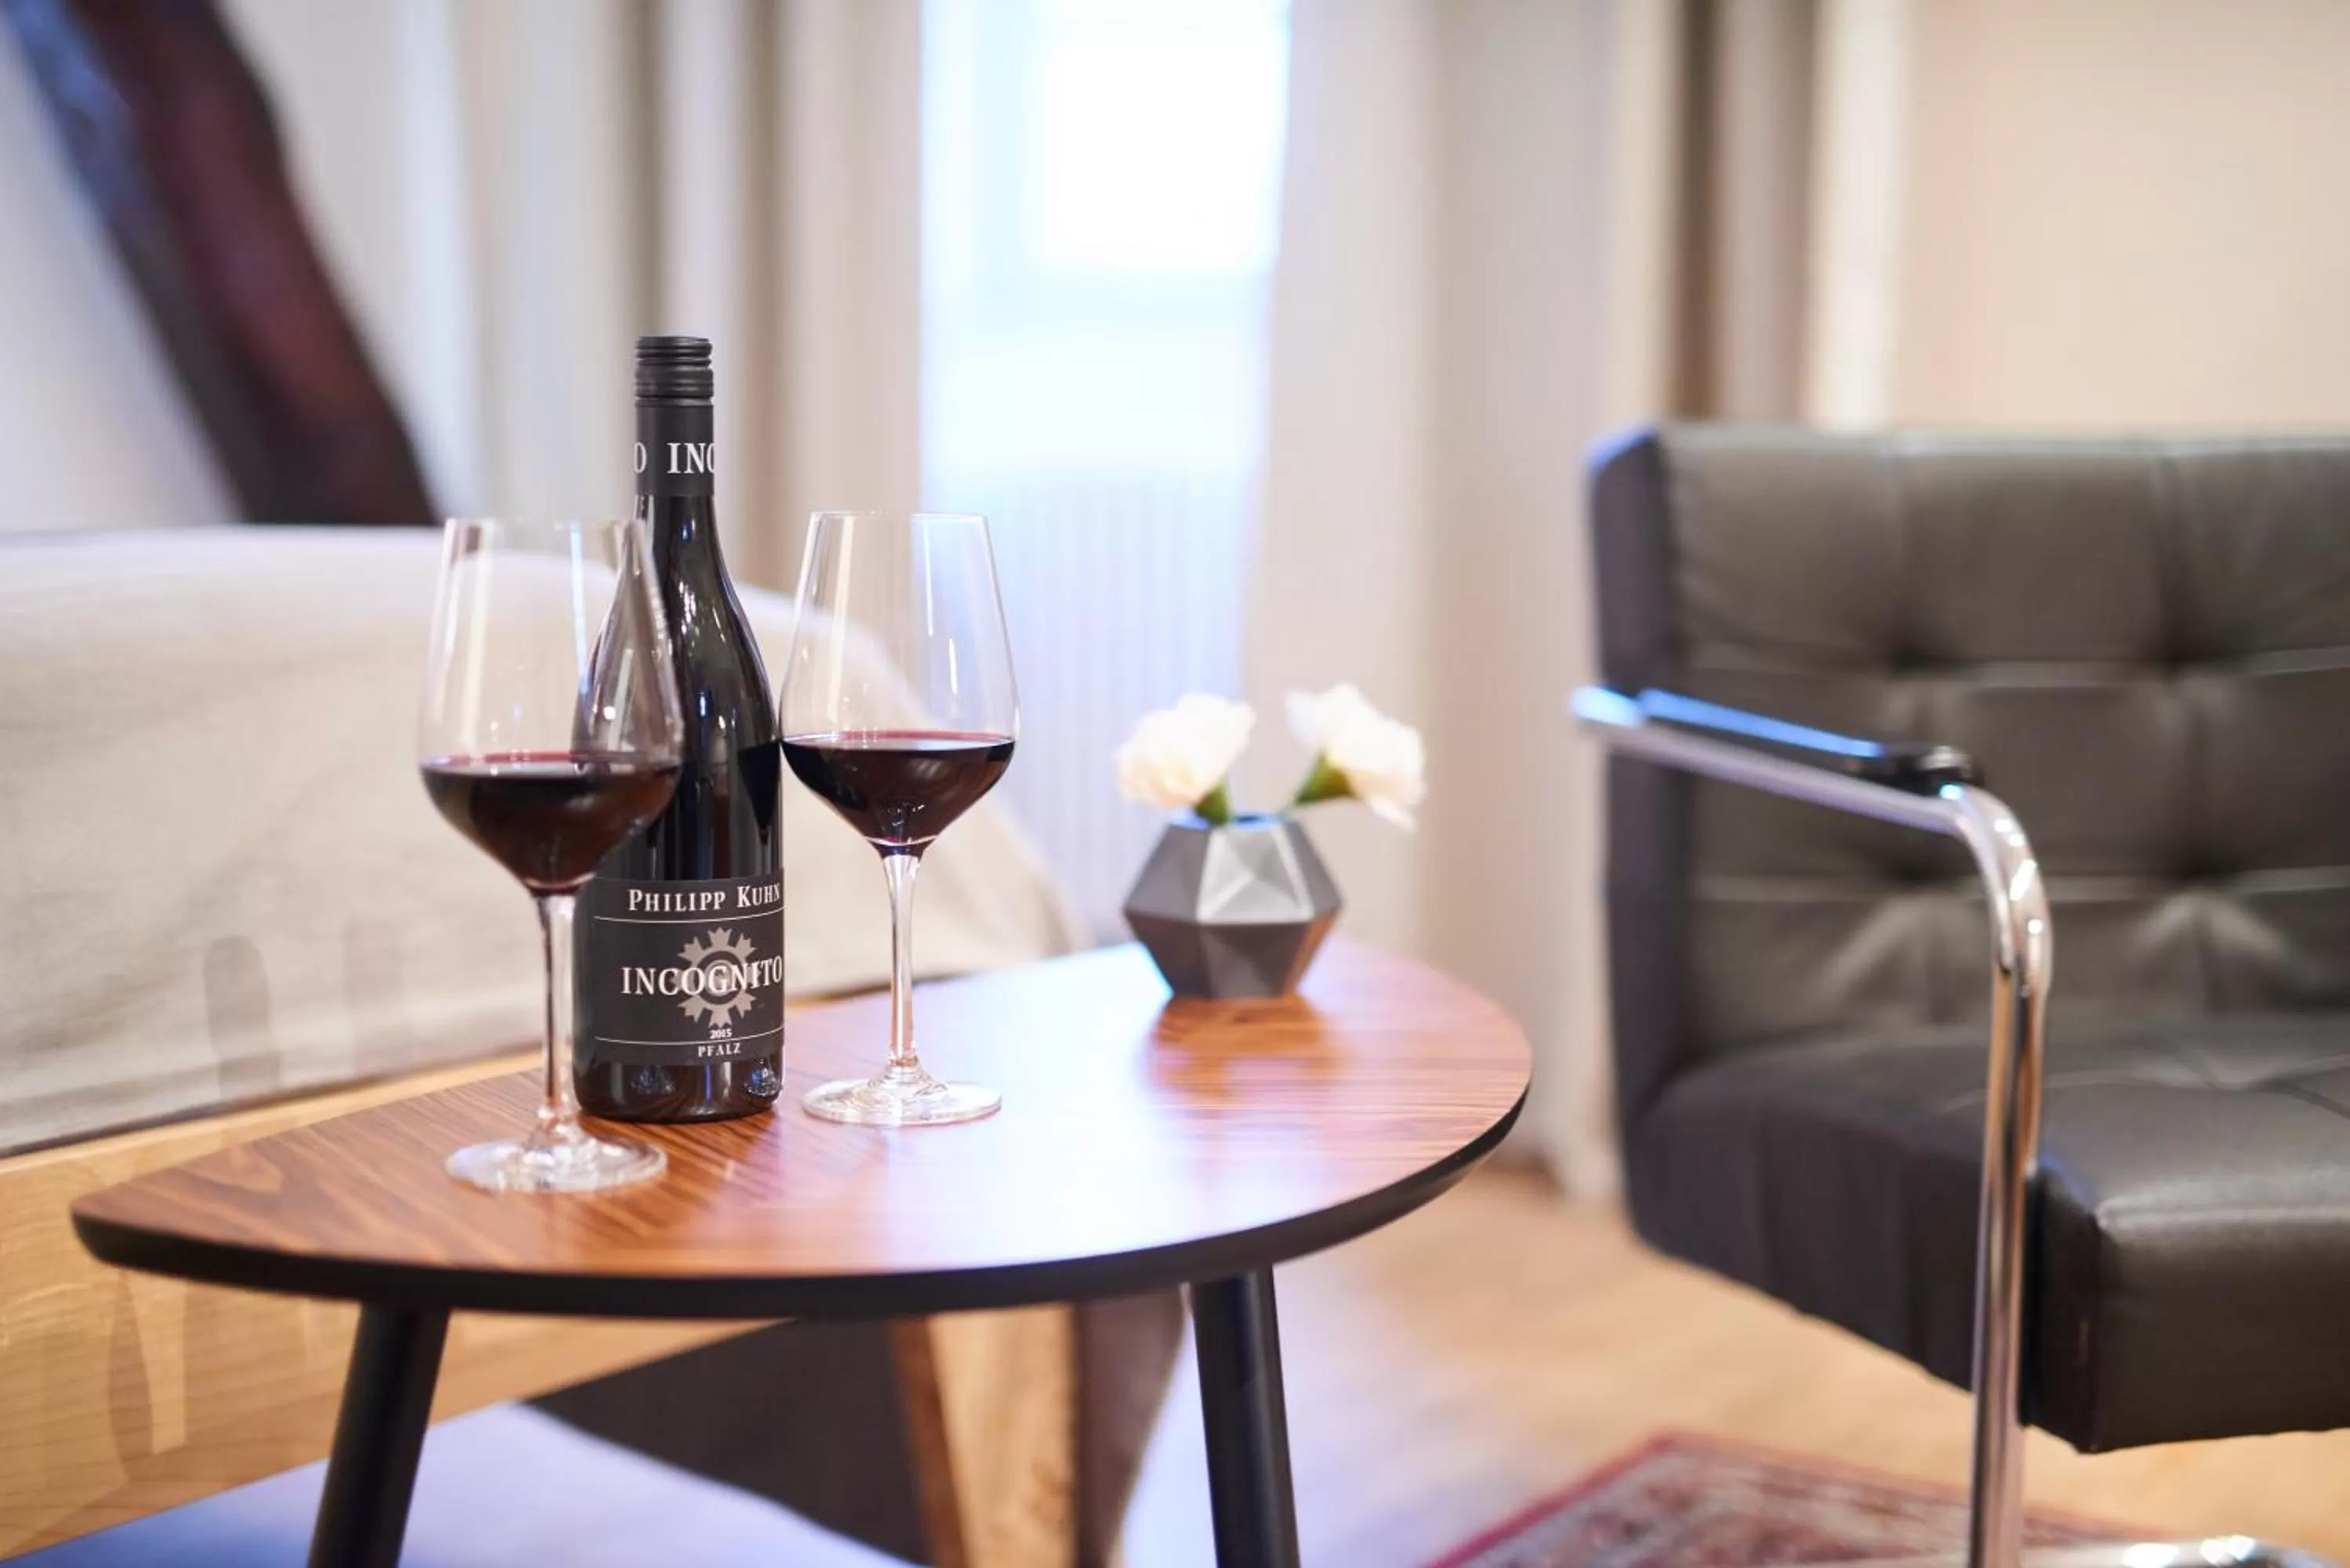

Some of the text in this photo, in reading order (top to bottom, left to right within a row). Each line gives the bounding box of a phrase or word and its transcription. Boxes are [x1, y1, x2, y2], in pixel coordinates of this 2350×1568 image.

[621, 955, 783, 995] INCOGNITO
[710, 1028, 732, 1039] 2015
[698, 1042, 740, 1057] PFALZ
